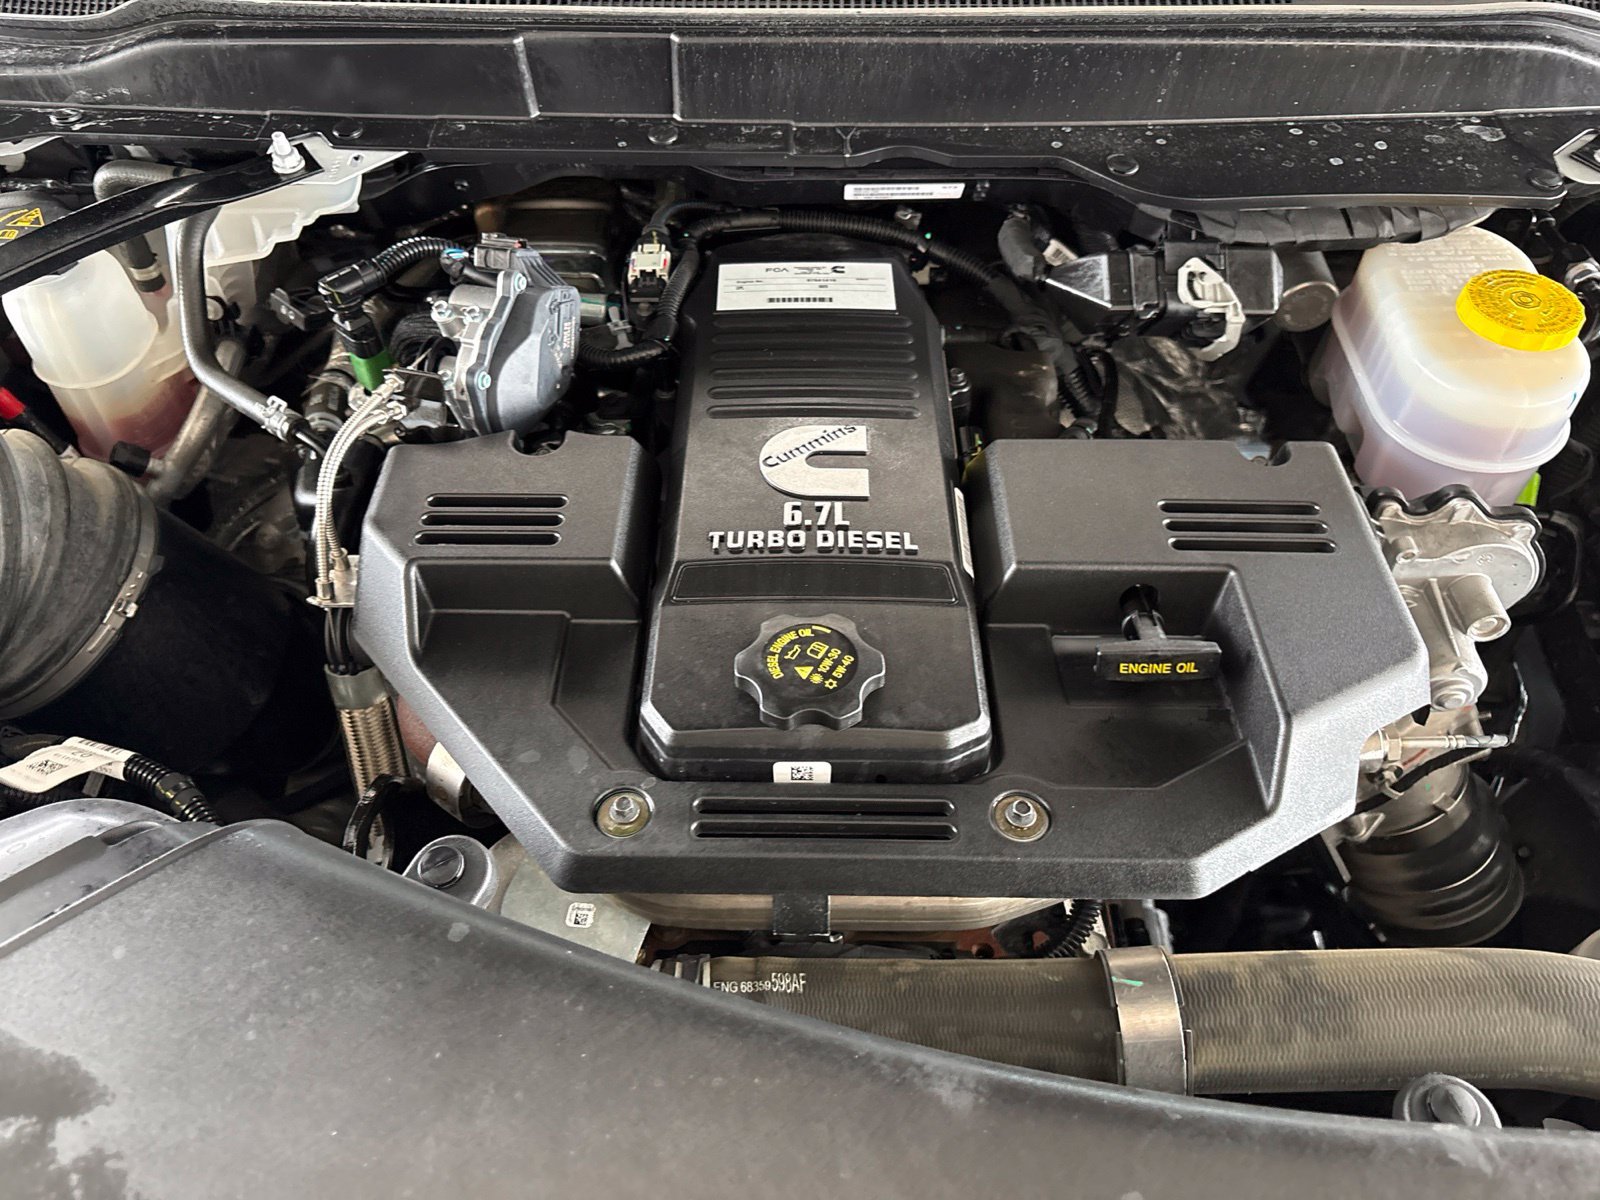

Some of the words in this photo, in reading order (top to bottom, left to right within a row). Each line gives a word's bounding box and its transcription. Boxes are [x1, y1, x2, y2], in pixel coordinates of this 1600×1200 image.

[762, 425, 857, 468] Cummins
[783, 501, 850, 529] 6.7L
[708, 530, 807, 554] TURBO
[816, 530, 919, 555] DIESEL
[769, 631, 799, 653] ENGINE
[797, 628, 815, 637] OIL
[767, 654, 784, 679] DIESEL
[817, 648, 842, 673] 10W-30
[832, 655, 855, 678] 5W-40
[1119, 663, 1172, 674] ENGINE
[1176, 662, 1199, 673] OIL
